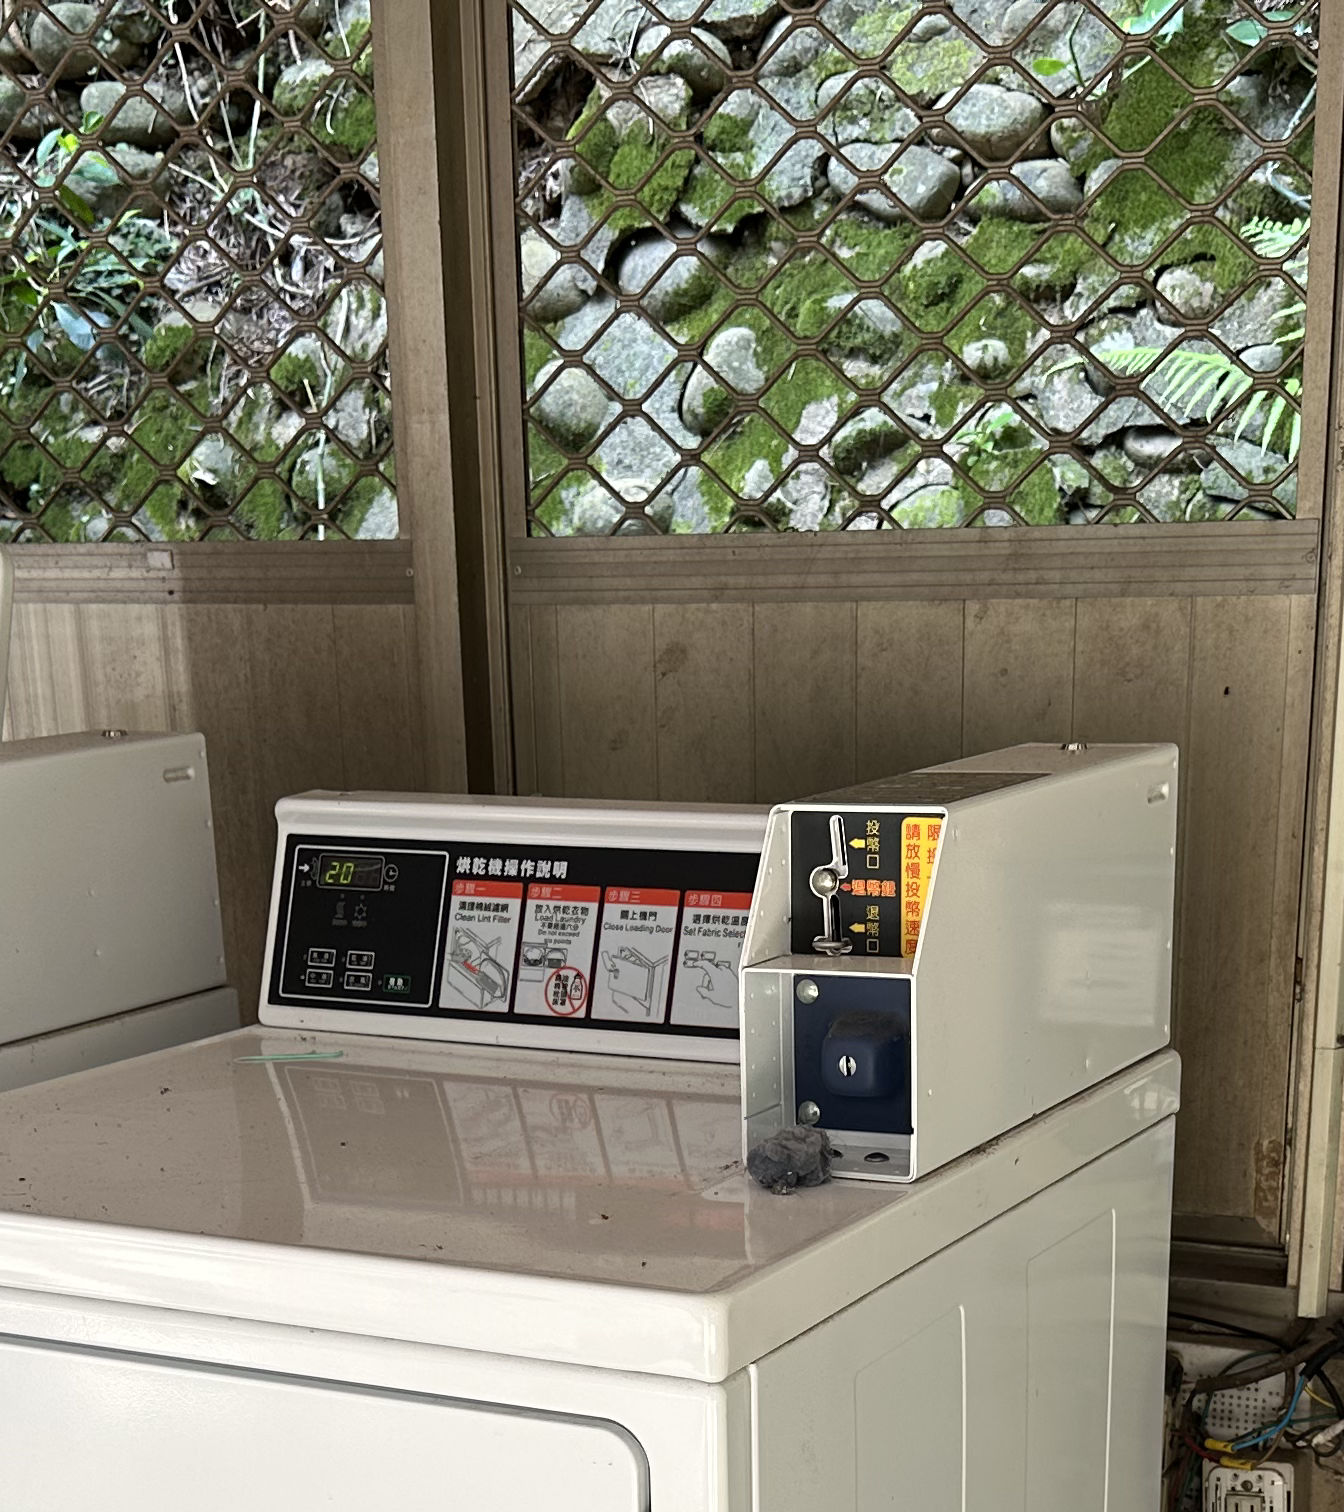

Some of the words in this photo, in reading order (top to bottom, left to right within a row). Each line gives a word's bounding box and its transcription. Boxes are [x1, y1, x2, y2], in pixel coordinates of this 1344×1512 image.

[865, 818, 881, 870] 投幣口
[325, 862, 354, 884] 20
[456, 856, 568, 879] 烘乾機操作說明
[455, 883, 486, 895] 步驟一
[530, 887, 562, 899] 步驟二
[851, 879, 897, 898] 退幣鈕
[905, 824, 921, 955] 請放慢投幣速度
[608, 891, 641, 903] 步驟三
[688, 894, 722, 906] 步驟四
[534, 904, 589, 916] 放入烘乾衣物
[620, 910, 657, 921] 關上機門
[455, 914, 475, 922] Clean
[477, 915, 491, 923] Lint
[535, 914, 553, 922] Load
[555, 916, 586, 925] Laundry
[604, 922, 623, 931] Close
[625, 923, 654, 934] Loading
[656, 925, 673, 933] Door
[683, 926, 697, 936] Set
[699, 927, 721, 937] Fabric
[723, 928, 747, 938] Selec
[865, 904, 880, 953] 退幣口
